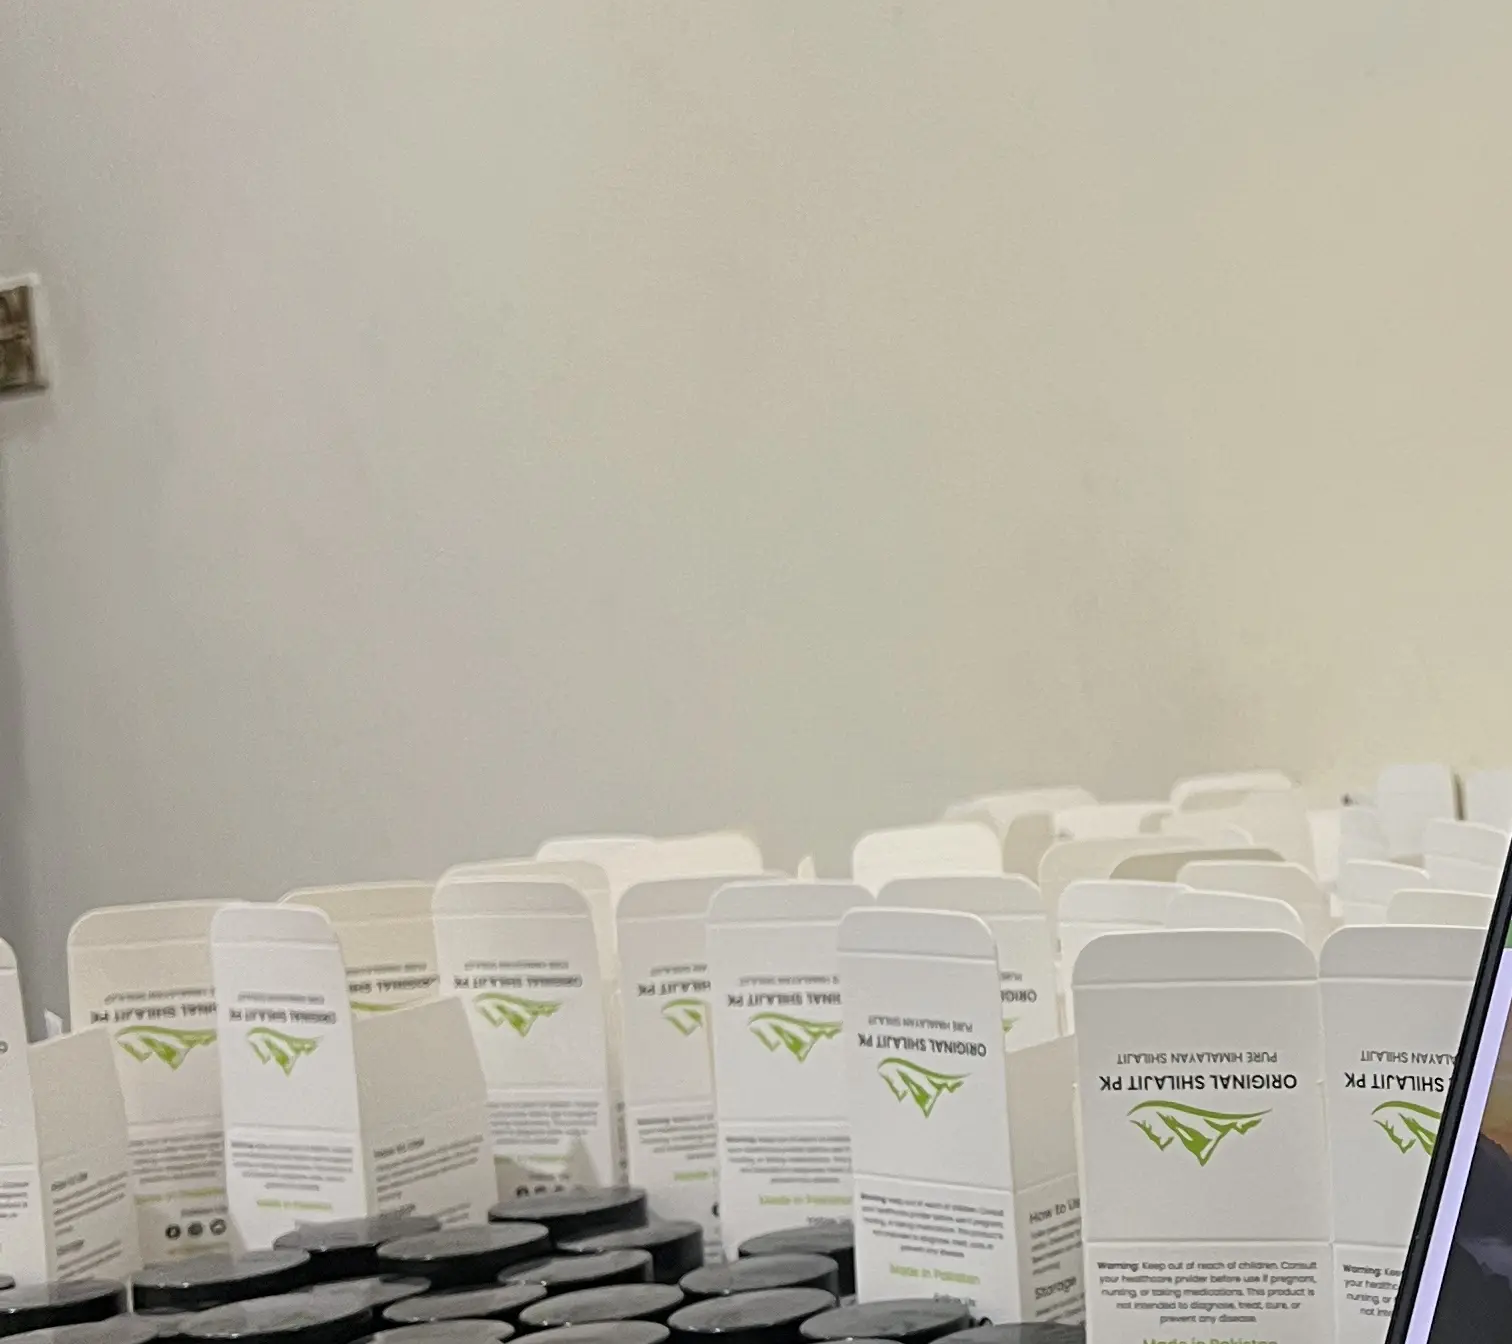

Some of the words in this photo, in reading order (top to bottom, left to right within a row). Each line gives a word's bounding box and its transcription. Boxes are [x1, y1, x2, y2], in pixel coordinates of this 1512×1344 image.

[928, 1038, 987, 1058] ORIGINAL
[1115, 1052, 1167, 1065] SHILAJIT
[1170, 1051, 1243, 1064] HIMALAYAN
[1247, 1051, 1278, 1064] PURE
[1359, 1050, 1408, 1064] SHILAJIT
[1097, 1075, 1122, 1091] PK
[1126, 1074, 1205, 1091] SHILAJIT
[1208, 1074, 1298, 1090] ORIGINAL
[1342, 1072, 1365, 1089] PK
[1370, 1073, 1445, 1093] SHILAJIT
